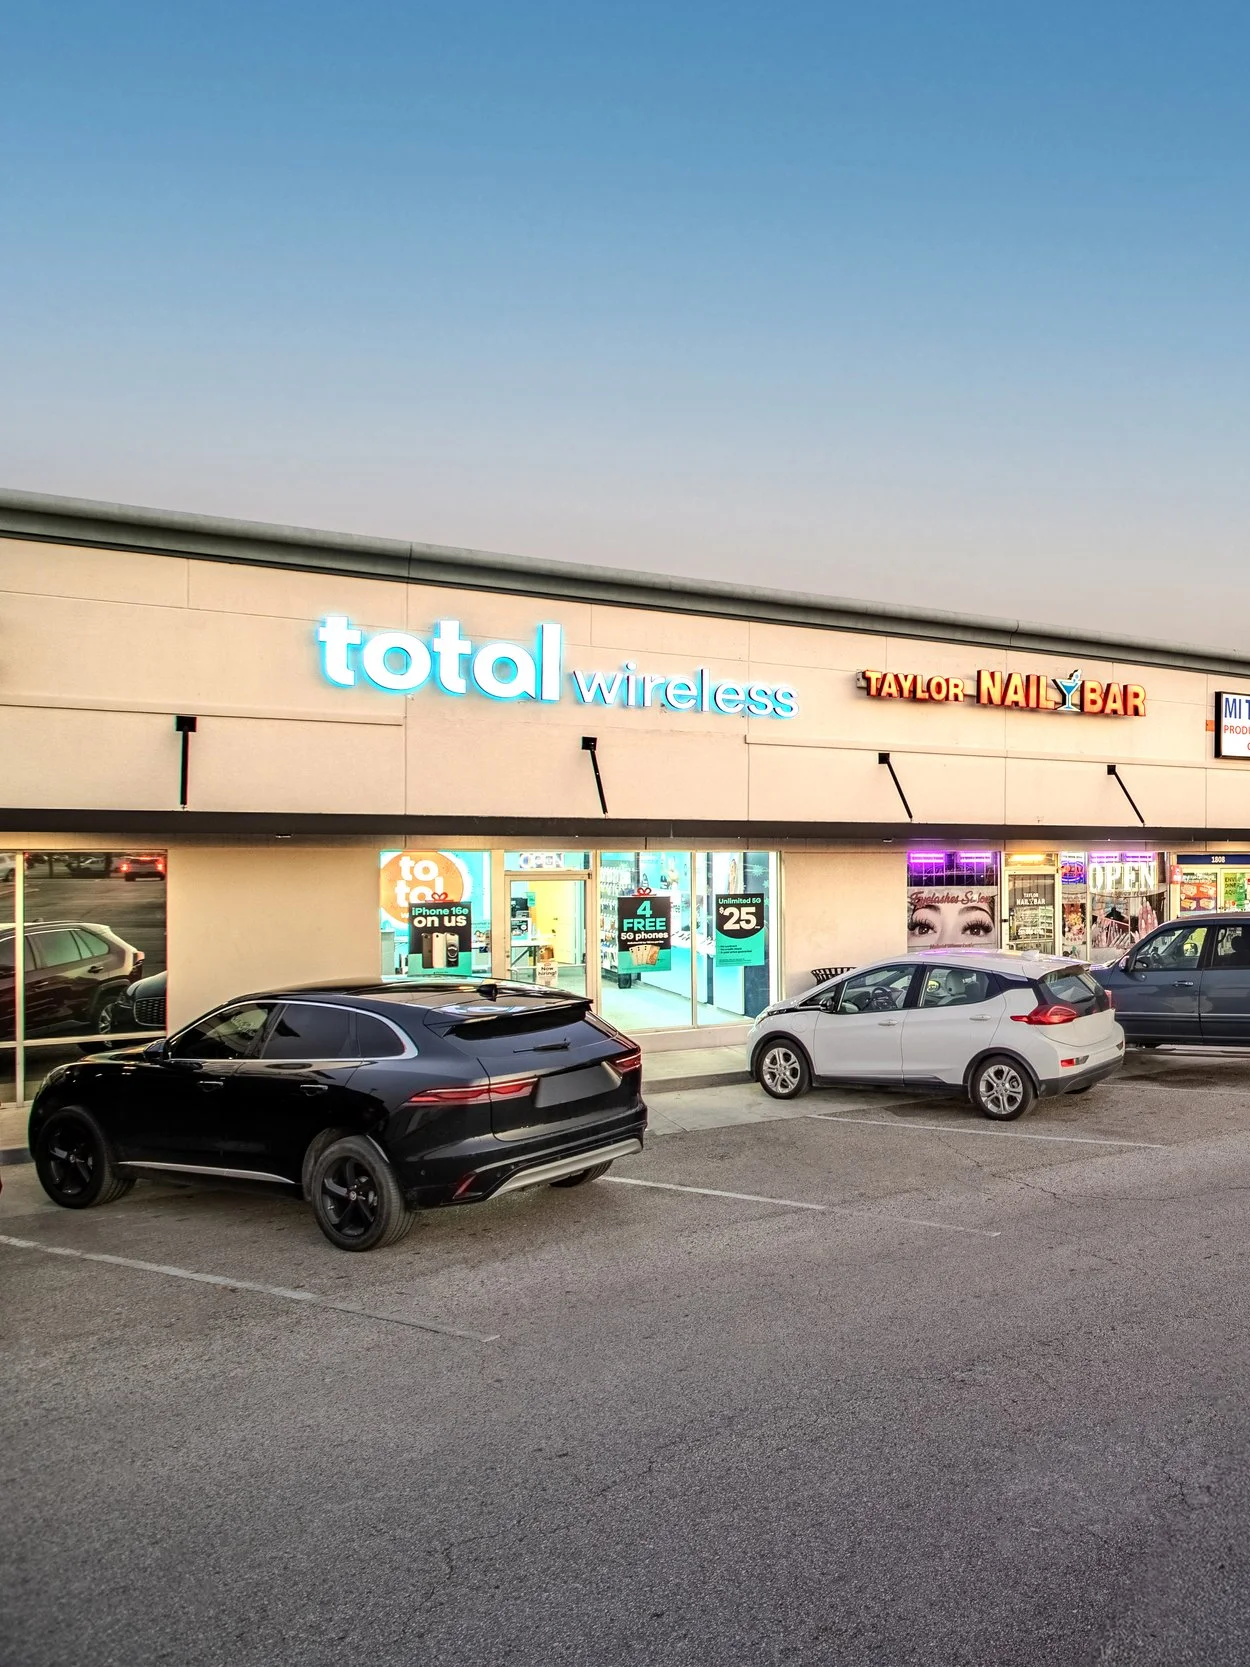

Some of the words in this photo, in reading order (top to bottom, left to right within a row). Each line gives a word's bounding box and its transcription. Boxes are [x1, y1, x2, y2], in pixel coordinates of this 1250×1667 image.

[318, 615, 562, 701] total
[573, 661, 800, 718] wireless
[864, 670, 965, 702] TAYLOR
[977, 669, 1056, 710] NAIL
[1081, 680, 1146, 716] BAR
[1224, 697, 1242, 719] MI
[399, 856, 439, 880] to
[1089, 861, 1156, 893] OPEN
[412, 907, 449, 915] iPhone
[451, 907, 468, 915] 16e
[636, 900, 653, 918] 4
[718, 906, 757, 930] $25
[413, 915, 439, 927] on
[443, 915, 467, 927] us
[623, 917, 667, 932] FREE
[620, 932, 634, 940] 5G
[635, 931, 669, 941] phones
